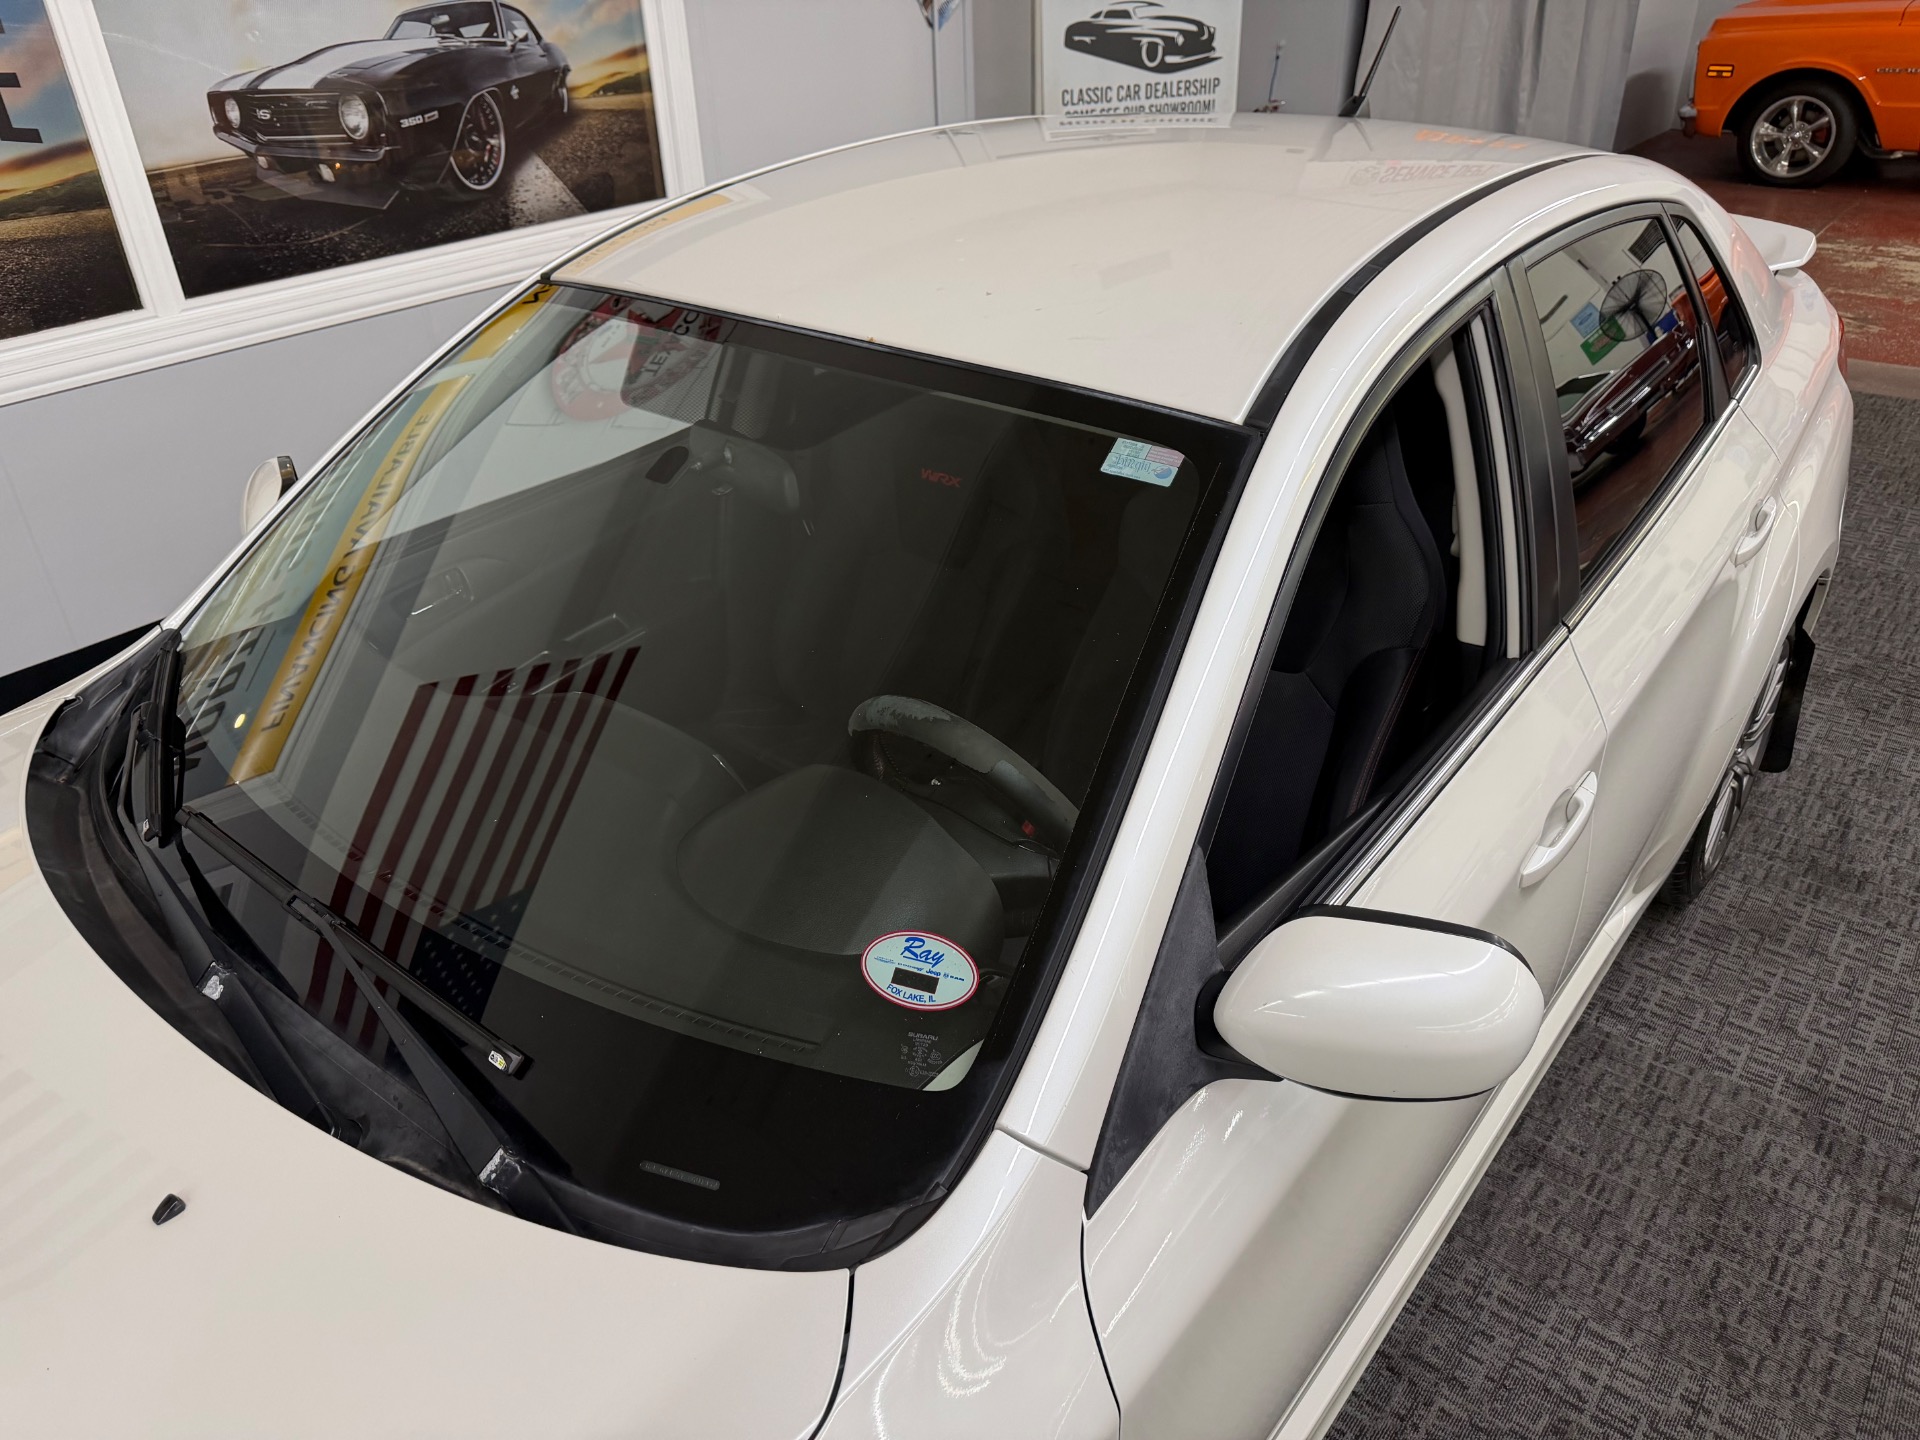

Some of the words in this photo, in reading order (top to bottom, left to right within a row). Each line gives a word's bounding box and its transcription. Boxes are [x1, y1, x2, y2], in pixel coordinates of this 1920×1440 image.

[1061, 86, 1113, 107] CLASSIC
[1116, 84, 1142, 103] CAR
[1145, 77, 1221, 100] DEALERSHIP
[399, 114, 424, 128] 350
[921, 468, 962, 488] WRX
[900, 936, 945, 968] Ray
[925, 968, 941, 977] Jeep
[886, 983, 903, 997] FOX
[902, 992, 927, 1004] LAKE,
[928, 995, 936, 1003] IL
